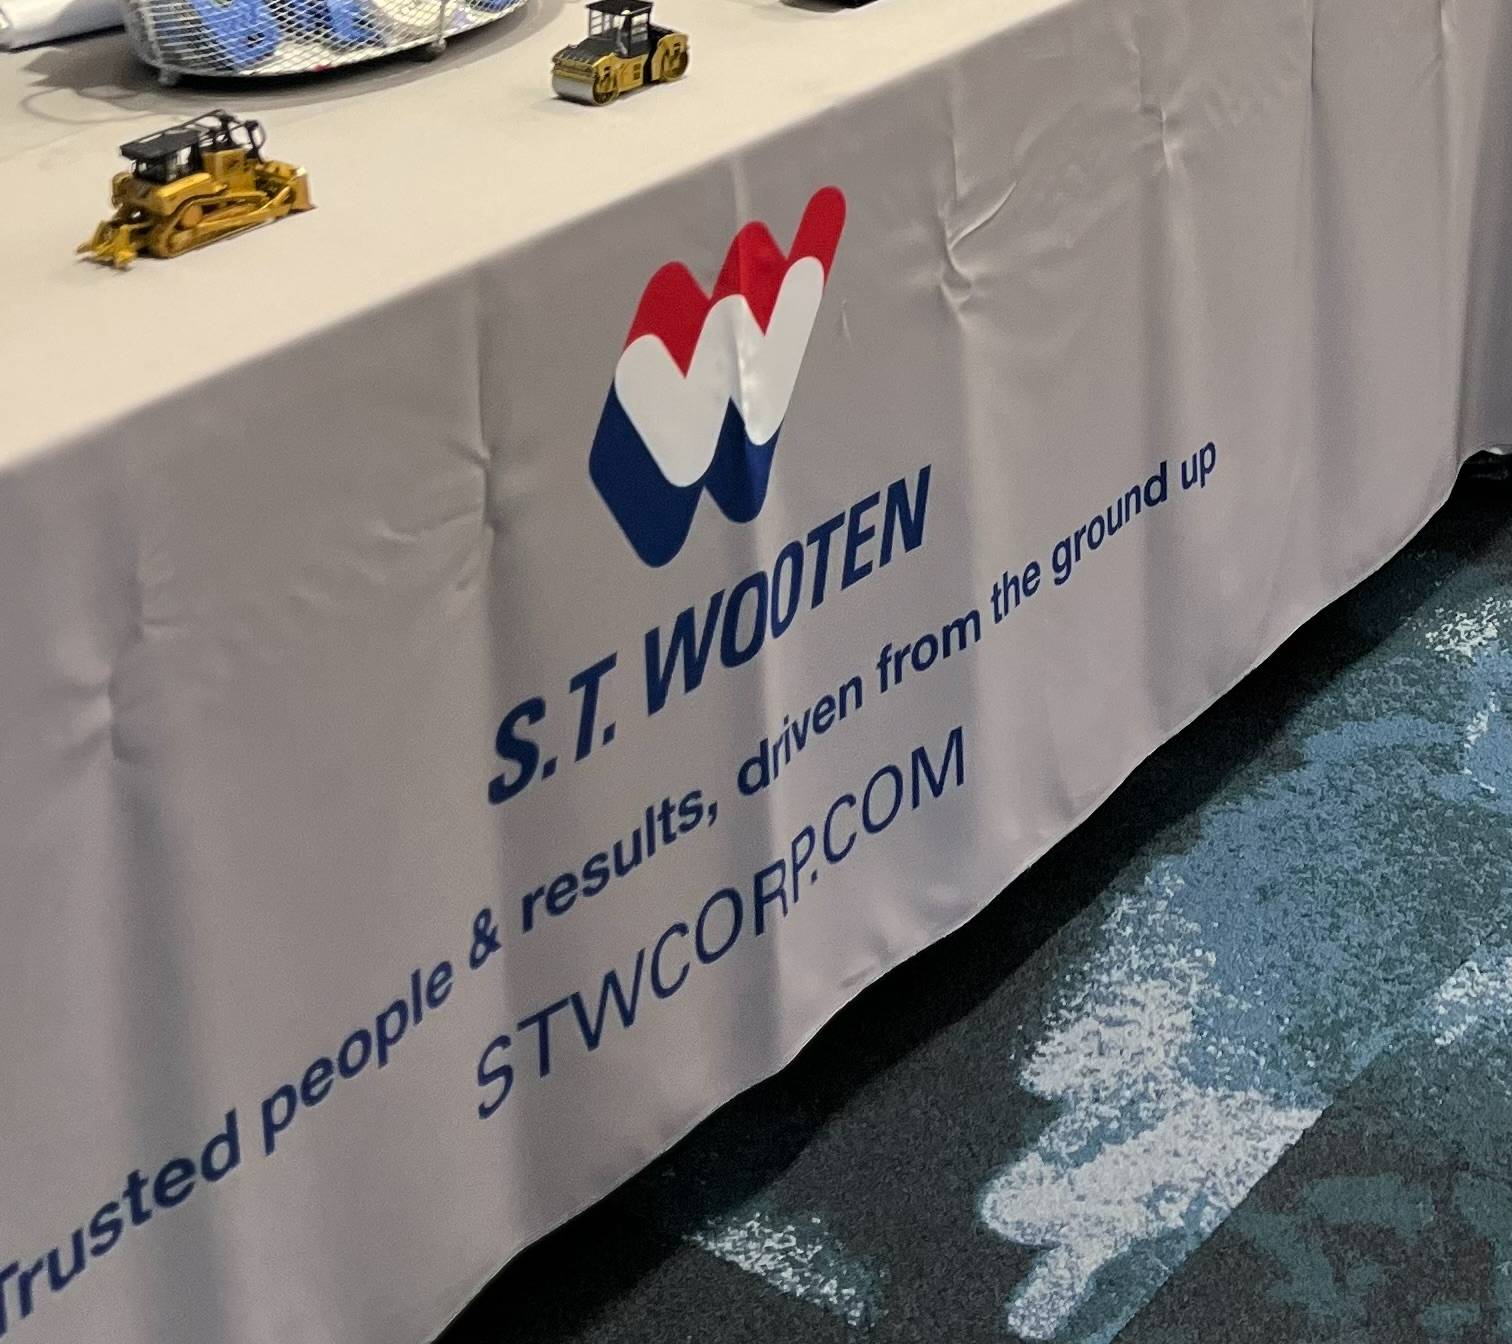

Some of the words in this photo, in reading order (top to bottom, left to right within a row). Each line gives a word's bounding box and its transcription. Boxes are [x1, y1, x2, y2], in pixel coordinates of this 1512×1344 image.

[260, 958, 455, 1157] people
[468, 906, 502, 970] &
[521, 784, 719, 933] results,
[736, 673, 863, 797] driven
[876, 608, 982, 694] from
[989, 559, 1042, 627] the
[1051, 461, 1168, 587] ground
[1180, 439, 1217, 493] up
[488, 651, 619, 807] S.T.
[642, 464, 933, 714] WOOTEN
[476, 725, 967, 1120] STWCORP.COM
